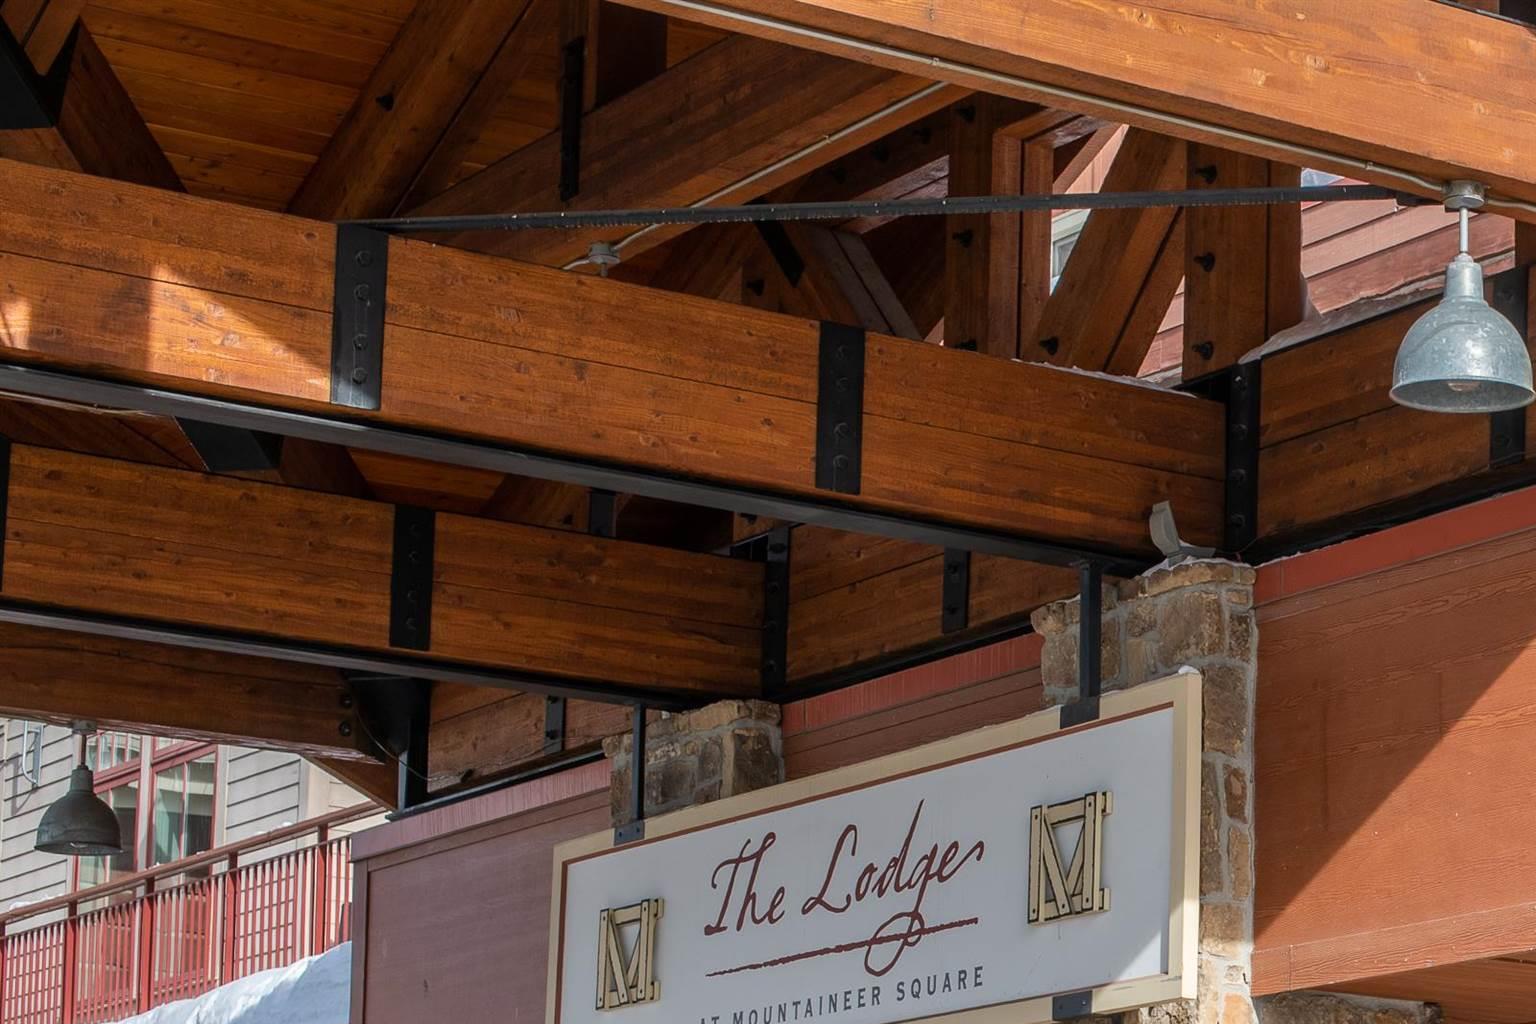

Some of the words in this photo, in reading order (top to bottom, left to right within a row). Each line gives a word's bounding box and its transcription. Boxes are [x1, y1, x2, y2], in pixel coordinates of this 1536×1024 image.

[704, 832, 785, 937] The
[801, 799, 984, 977] Lodge
[896, 965, 984, 1002] SQUARE
